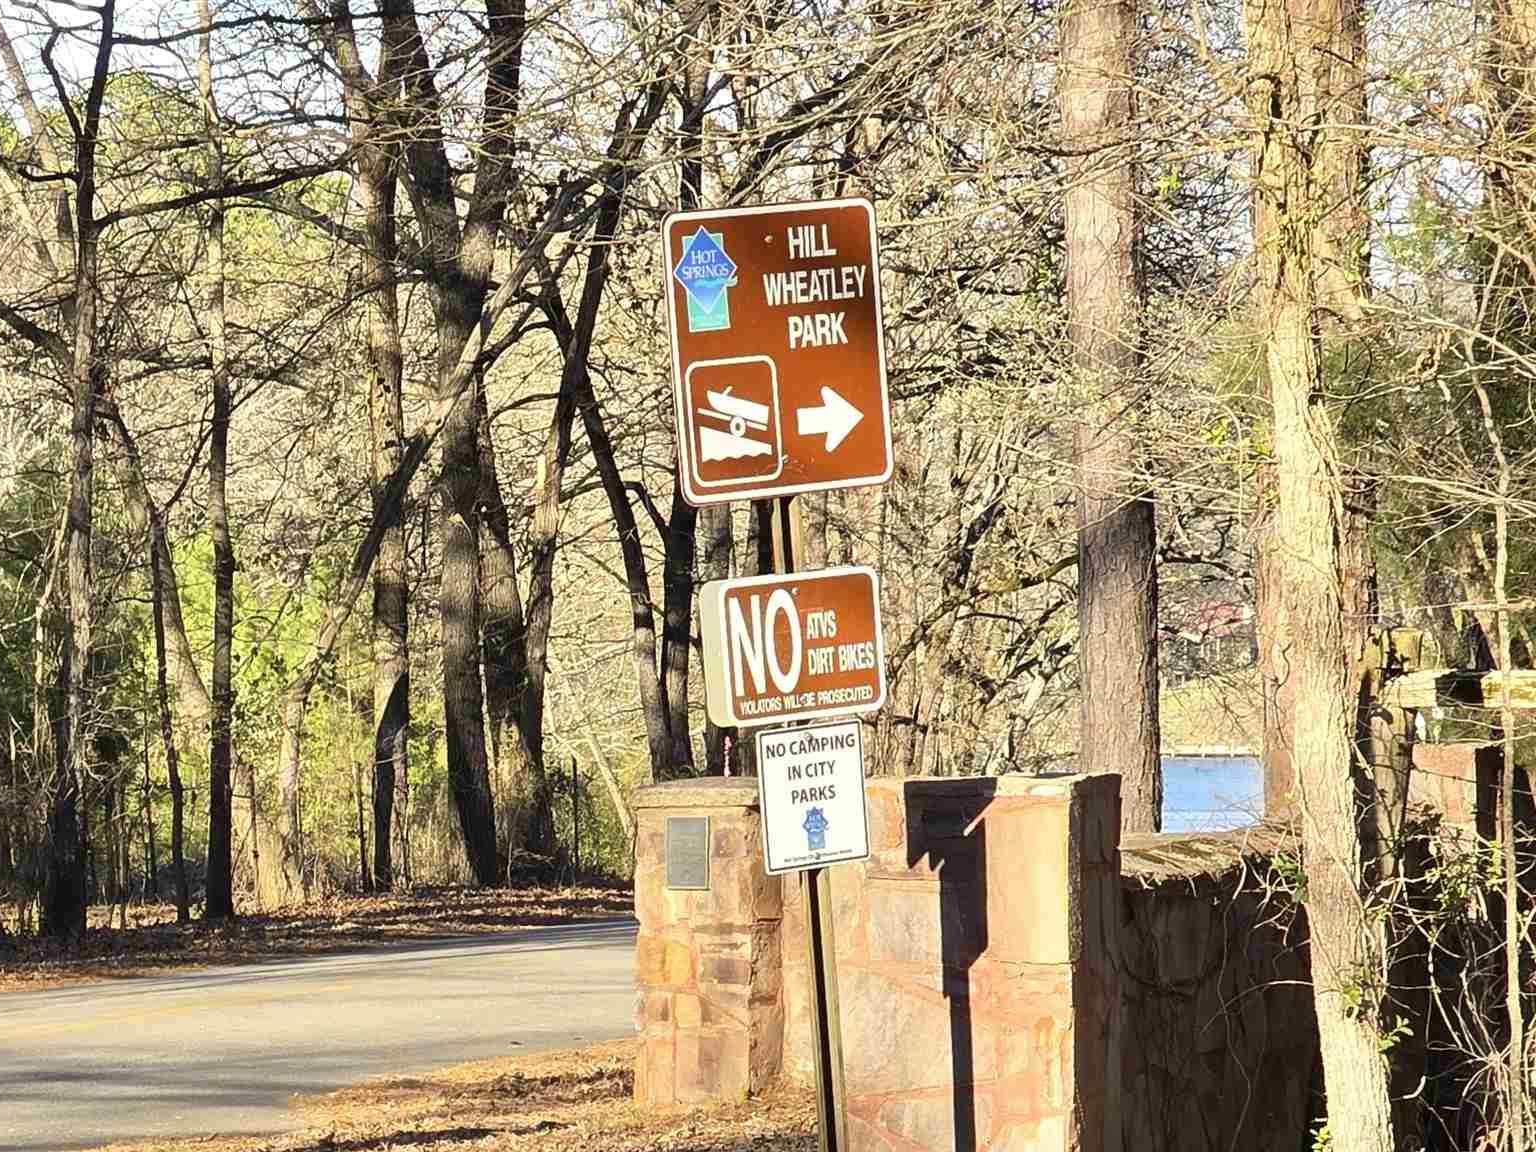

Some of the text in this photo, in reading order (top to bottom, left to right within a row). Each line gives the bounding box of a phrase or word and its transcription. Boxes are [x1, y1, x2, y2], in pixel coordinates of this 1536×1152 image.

[787, 223, 837, 259] HILL
[681, 263, 729, 280] SPRINGS
[690, 249, 718, 265] HOT
[763, 264, 866, 306] WHEATLEY
[787, 311, 848, 349] PARK
[807, 609, 837, 640] ATVS
[728, 588, 802, 697] NO
[807, 641, 874, 675] DIRT BIKES
[740, 696, 782, 715] VIOLATORS
[783, 694, 801, 711] WILL
[817, 685, 873, 704] PROSECUTED
[766, 733, 856, 759] NO CAMPING
[787, 759, 836, 780] IN CITY
[791, 784, 837, 805] PARKS
